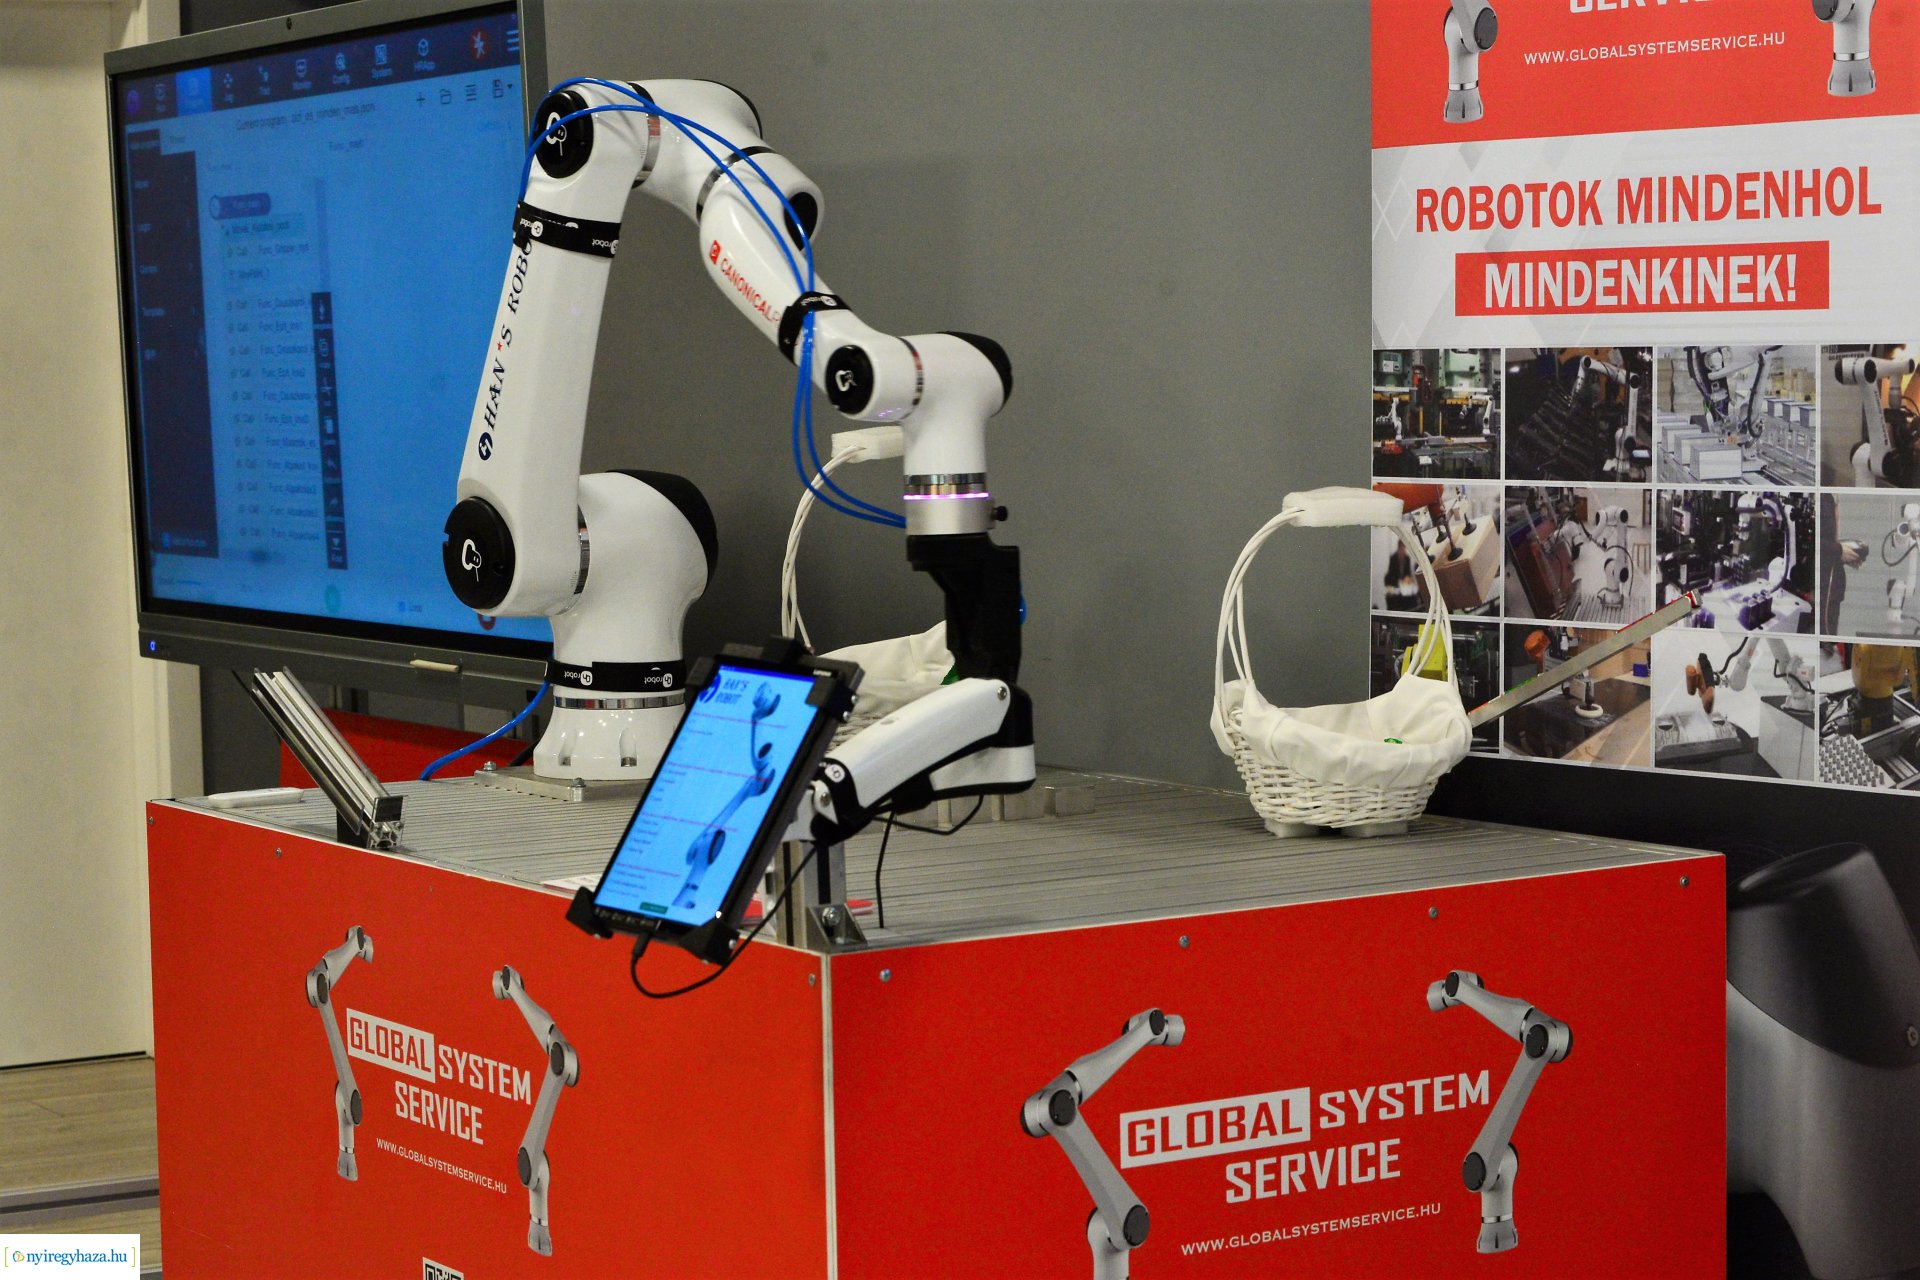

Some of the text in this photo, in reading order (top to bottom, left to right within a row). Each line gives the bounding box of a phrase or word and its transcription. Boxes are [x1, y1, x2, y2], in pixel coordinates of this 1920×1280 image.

[1523, 31, 1787, 65] WWW.GLOBALSYSTEMSERVICE.HU
[1416, 165, 1883, 233] ROBOTOK MINDENHOL
[507, 239, 532, 315] ROBO
[1484, 253, 1797, 309] MINDENKINEK!
[349, 1016, 531, 1105] GLOBAL SYSTEM
[394, 1080, 484, 1145] SERVICE
[1127, 1069, 1490, 1158] GLOBAL SYSTEM
[376, 1137, 507, 1194] WWW.GLOBALSYSTEMSERVICE.HU
[1225, 1138, 1401, 1204] SERVICE
[1180, 1202, 1442, 1256] WWW.GLOBALSYSTEMSERVICE.HU
